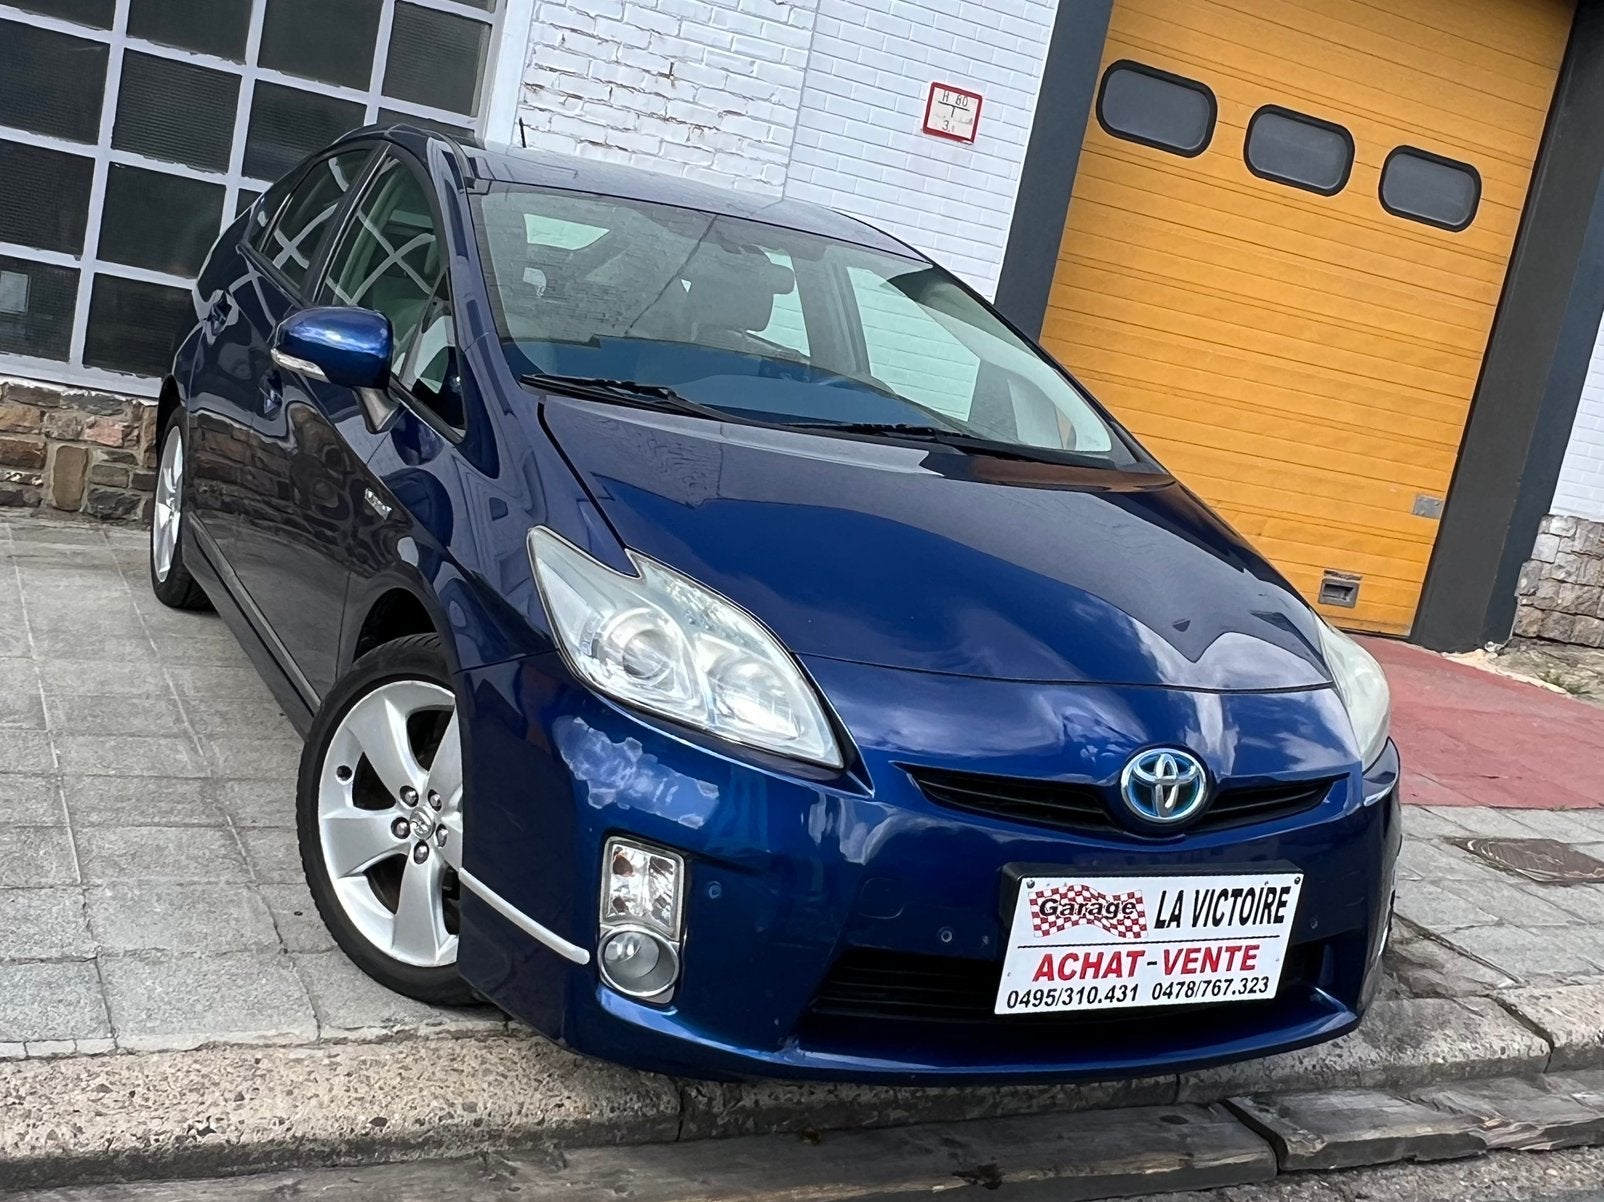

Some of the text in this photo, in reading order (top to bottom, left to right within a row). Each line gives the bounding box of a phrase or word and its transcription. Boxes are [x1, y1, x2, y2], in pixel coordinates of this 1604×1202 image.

[1039, 886, 1291, 930] Garage LA VICTOIRE
[1006, 976, 1269, 1009] 0495/310.431 0478/767.323
